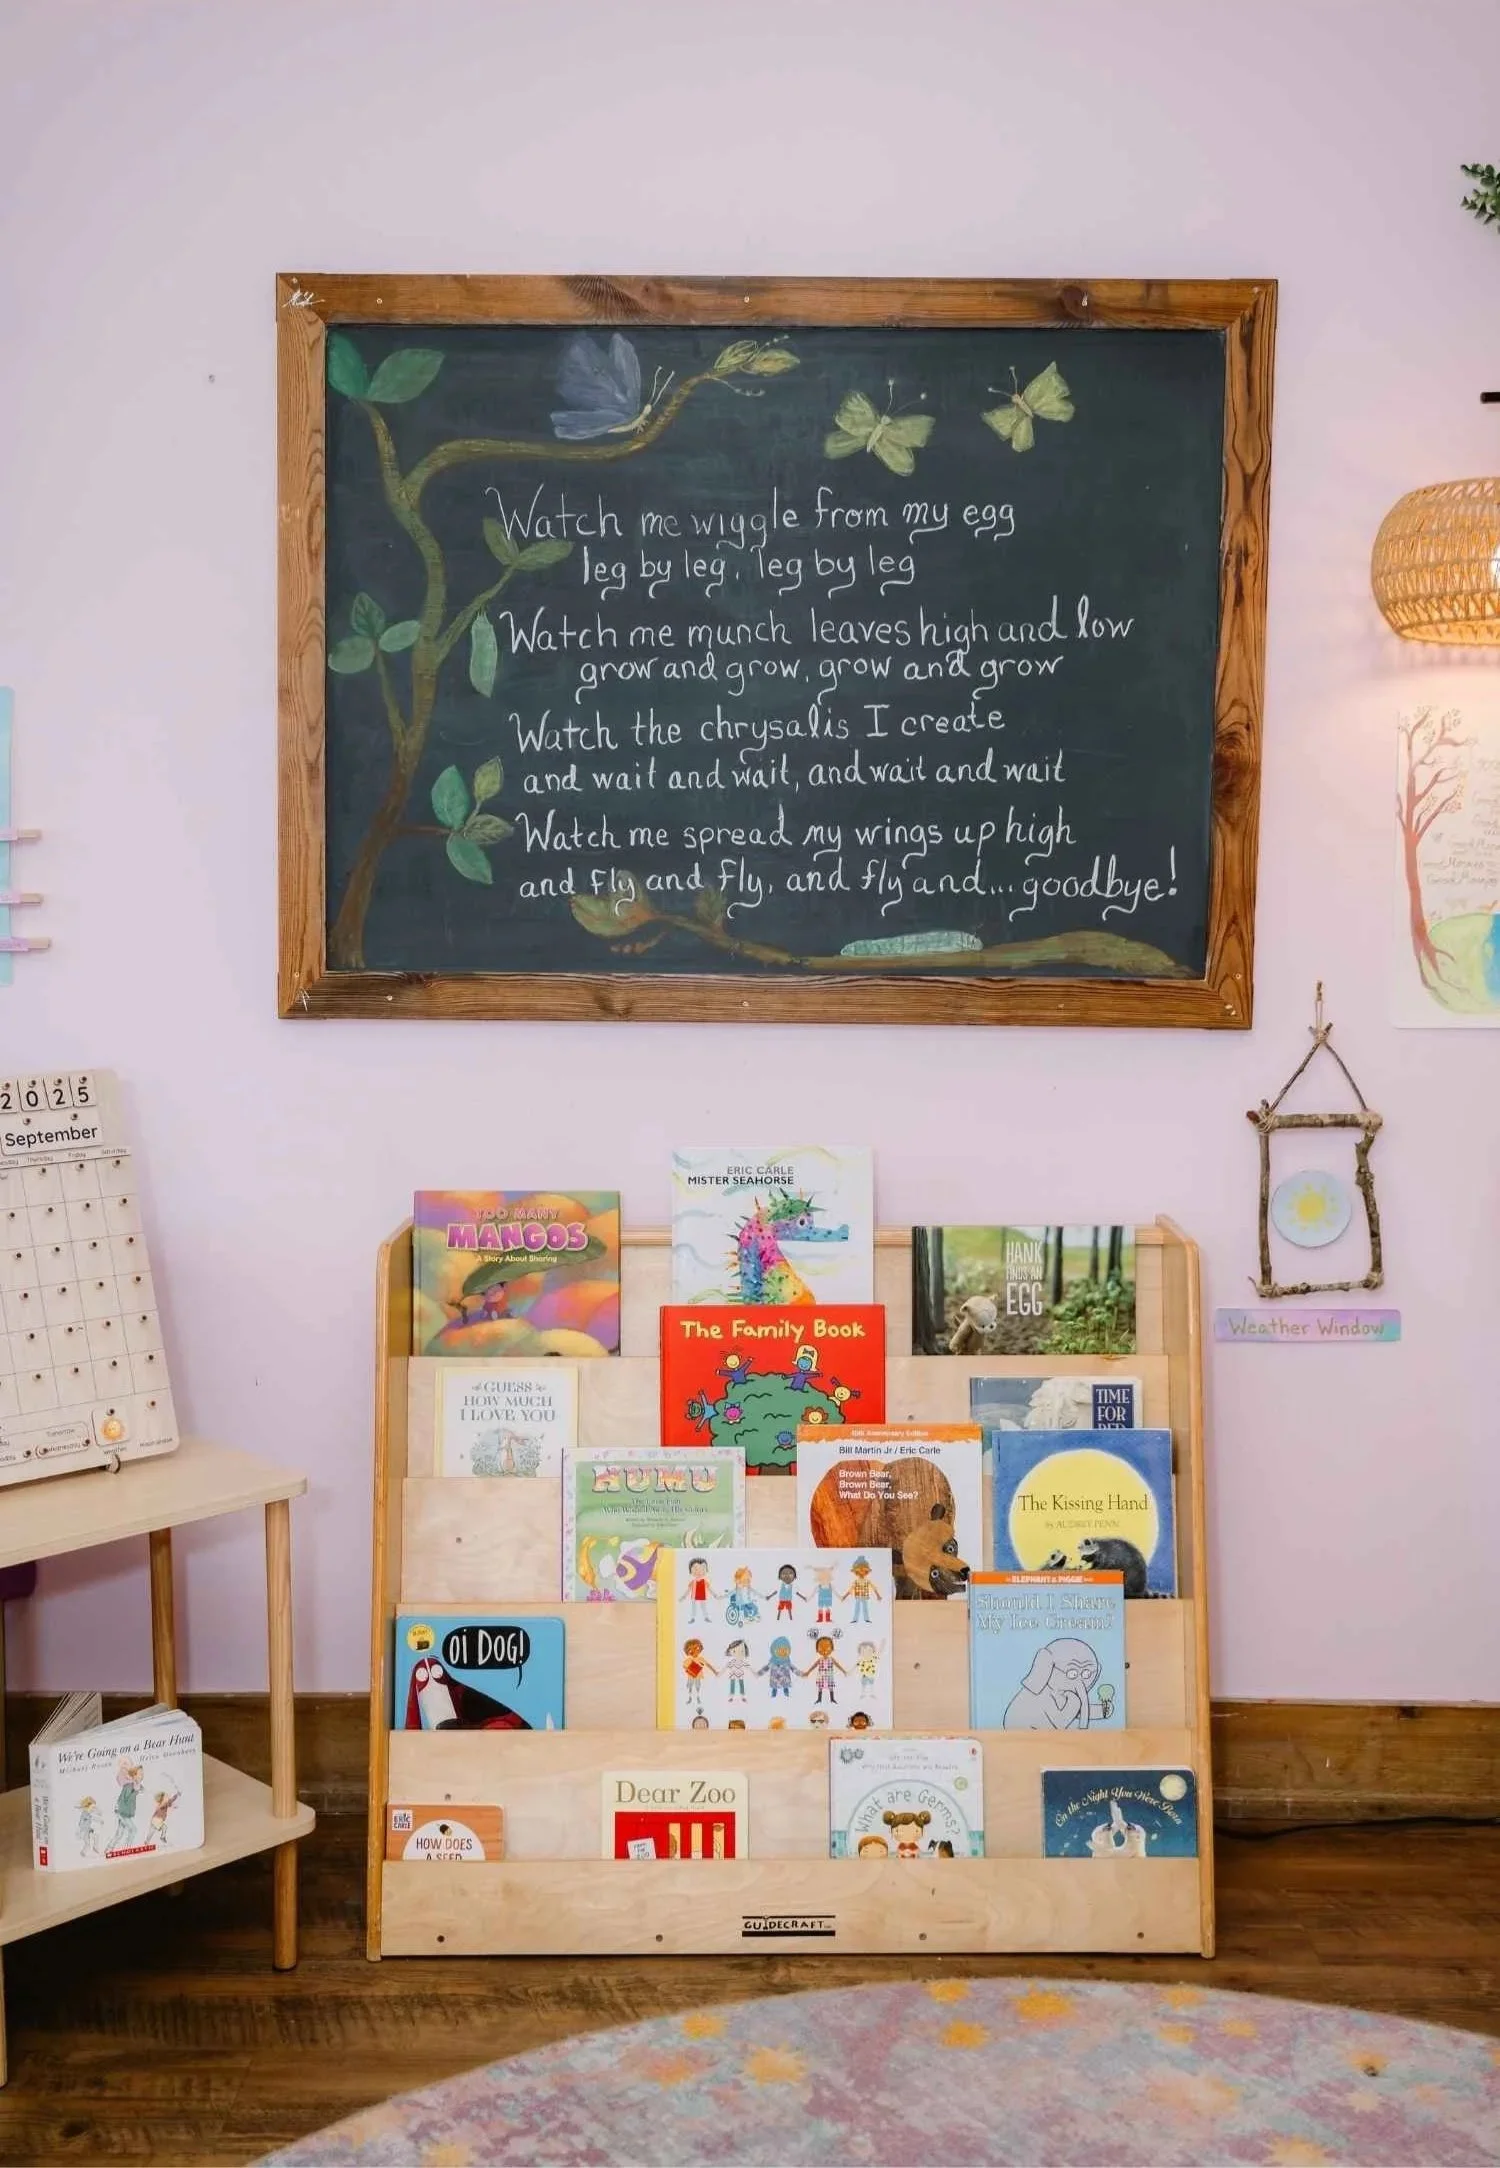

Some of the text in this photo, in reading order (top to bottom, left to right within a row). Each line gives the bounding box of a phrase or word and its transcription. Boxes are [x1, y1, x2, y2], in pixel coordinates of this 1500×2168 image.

[485, 483, 1015, 552] Watch me wiggle from my egg
[583, 545, 627, 600] leg
[640, 549, 671, 599] by
[758, 547, 802, 596] leg
[815, 548, 856, 599] by
[869, 544, 916, 596] leg
[499, 595, 1135, 654] Watch me munch leaves high and low
[576, 657, 659, 704] grow
[663, 651, 718, 681] and
[817, 656, 892, 705] grow
[903, 650, 971, 680] and
[972, 656, 1064, 700] grow
[509, 701, 1005, 764] Watch the chrysalis I create
[523, 747, 1066, 794] and wait and wait, and wait and wait
[515, 804, 1077, 869] Watch me spread my wings up high
[519, 868, 575, 898] and
[645, 862, 704, 891] and
[786, 857, 850, 892] and
[861, 859, 903, 916] fly
[1009, 846, 1177, 922] goodbye!
[5, 1126, 98, 1148] September
[688, 1176, 794, 1185] MISTER SEAHORSE
[727, 1166, 794, 1175] ERIC CARLE
[446, 1222, 589, 1252] MANGOS
[484, 1255, 503, 1264] Story
[529, 1255, 557, 1264] Sharing
[1006, 1241, 1043, 1264] HANK
[1006, 1282, 1043, 1316] EGG
[680, 1319, 866, 1343] The Family Book
[1228, 1316, 1385, 1336] Weather Window
[483, 1381, 533, 1393] GUESS
[1095, 1388, 1130, 1404] TIME
[464, 1395, 552, 1407] HOW MUCH
[471, 1408, 515, 1422] LOVE
[519, 1408, 556, 1422] YOU
[1097, 1406, 1127, 1421] FOR
[839, 1446, 852, 1455] Bill
[854, 1446, 881, 1455] Martin
[884, 1446, 893, 1455] Jr
[900, 1446, 917, 1455] Eric
[918, 1446, 941, 1455] Carle
[592, 1465, 719, 1493] HUMU
[839, 1470, 892, 1479] Brown Bear,
[839, 1480, 892, 1490] Brown Bear,
[839, 1491, 919, 1500] What Do You See?
[1018, 1494, 1148, 1514] The Kissing Hand
[976, 1593, 1042, 1611] Should
[1060, 1593, 1115, 1611] Share
[977, 1613, 1114, 1634] My Ice Cream?
[87, 1747, 117, 1758] Going
[120, 1745, 131, 1754] on
[143, 1739, 166, 1750] Bear
[169, 1733, 195, 1747] Hunt
[616, 1781, 736, 1804] Dear Zoo
[855, 1787, 961, 1836] What are Germs?
[1067, 1801, 1081, 1814] the
[1081, 1788, 1108, 1806] Night
[1110, 1786, 1132, 1801] You
[1158, 1800, 1183, 1826] Born
[416, 1838, 473, 1850] HOW DOES
[744, 1919, 824, 1930] GUIDECRAFT
